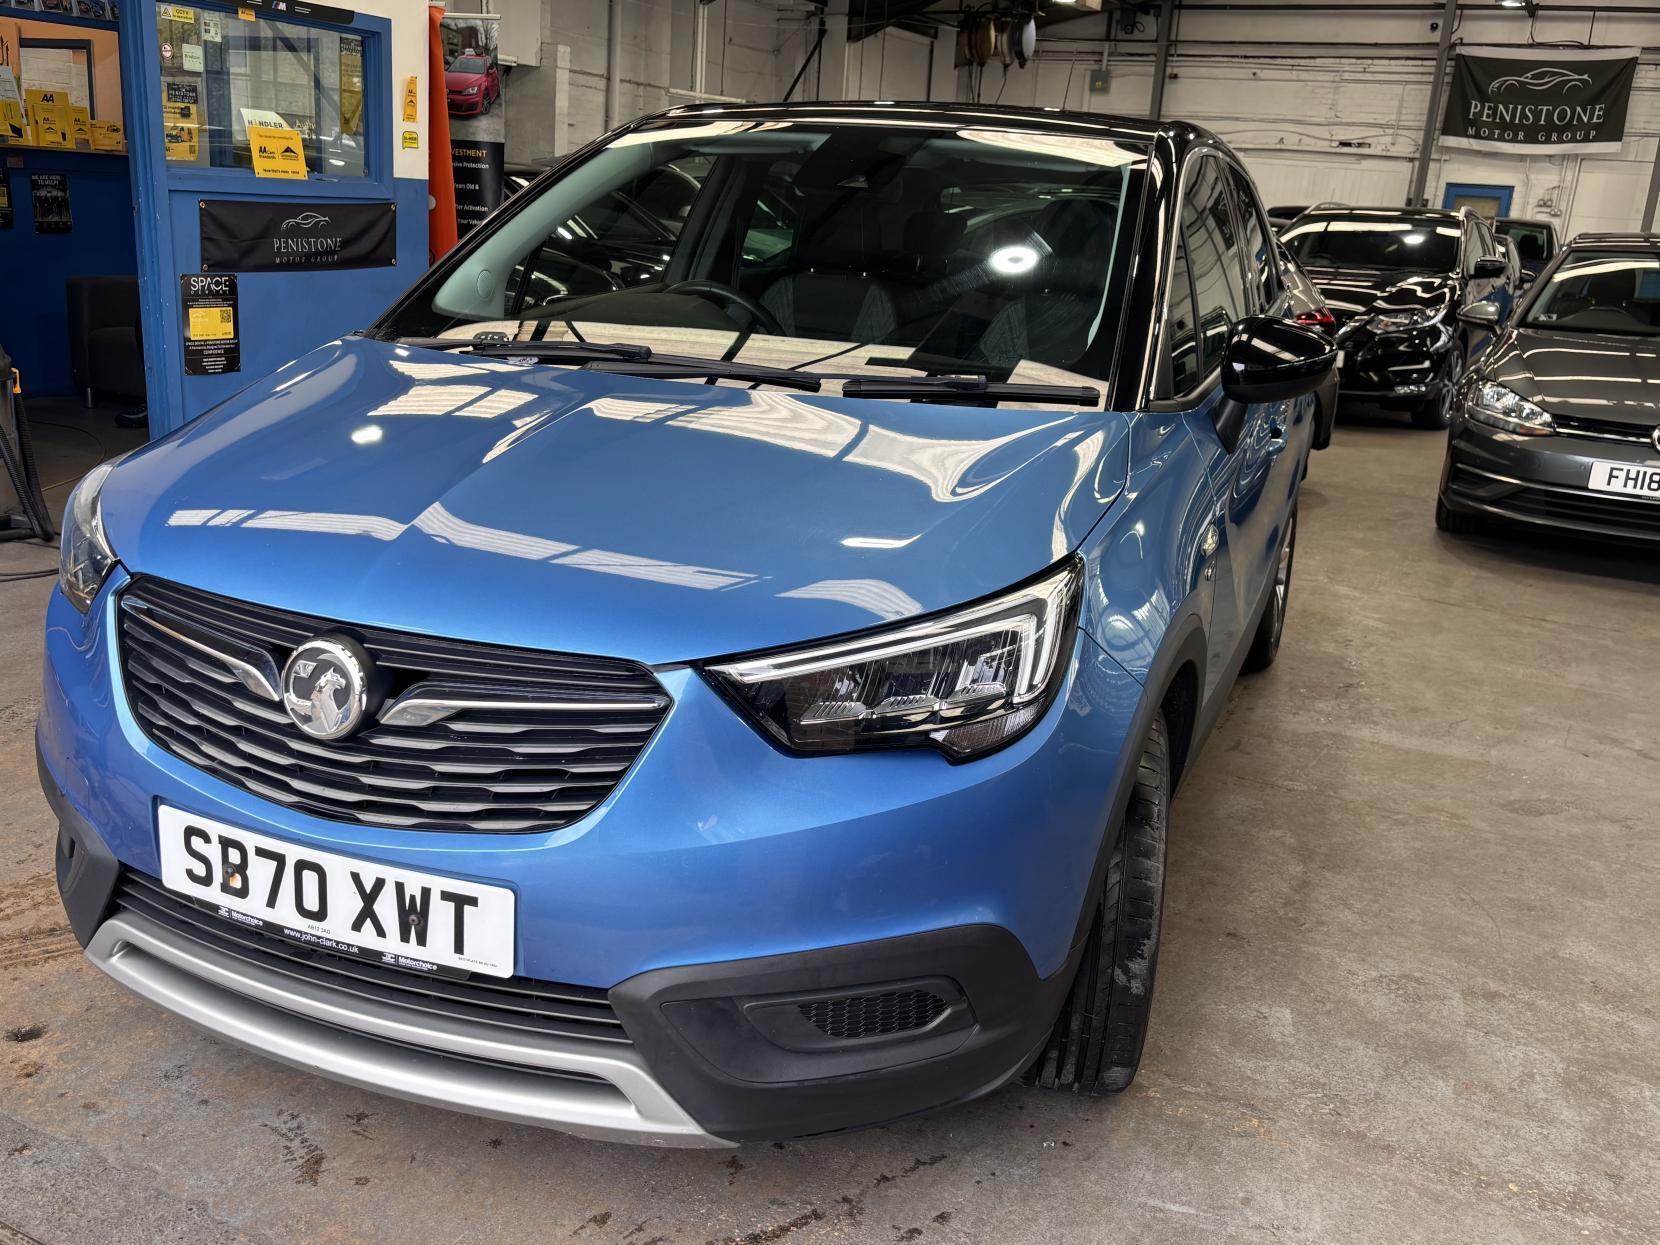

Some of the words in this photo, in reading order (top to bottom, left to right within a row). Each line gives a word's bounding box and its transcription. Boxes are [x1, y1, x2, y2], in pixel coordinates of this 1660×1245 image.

[41, 94, 54, 103] AA
[1468, 100, 1605, 126] PENISTONE
[1467, 126, 1525, 141] MOTOR
[1538, 130, 1597, 142] GROUP
[452, 149, 487, 157] VESTMENT
[464, 204, 488, 212] Activation
[273, 238, 342, 252] PENISTONE
[275, 256, 306, 264] MOTOR
[311, 255, 338, 263] GROUP
[190, 277, 229, 291] SPACE
[1606, 467, 1660, 492] FH18
[183, 824, 328, 923] SB70
[350, 870, 479, 956] XWT
[231, 910, 263, 926] Motorchoice
[283, 926, 359, 954] www.john-clark.co.uk
[398, 956, 437, 971] Motorchoice
